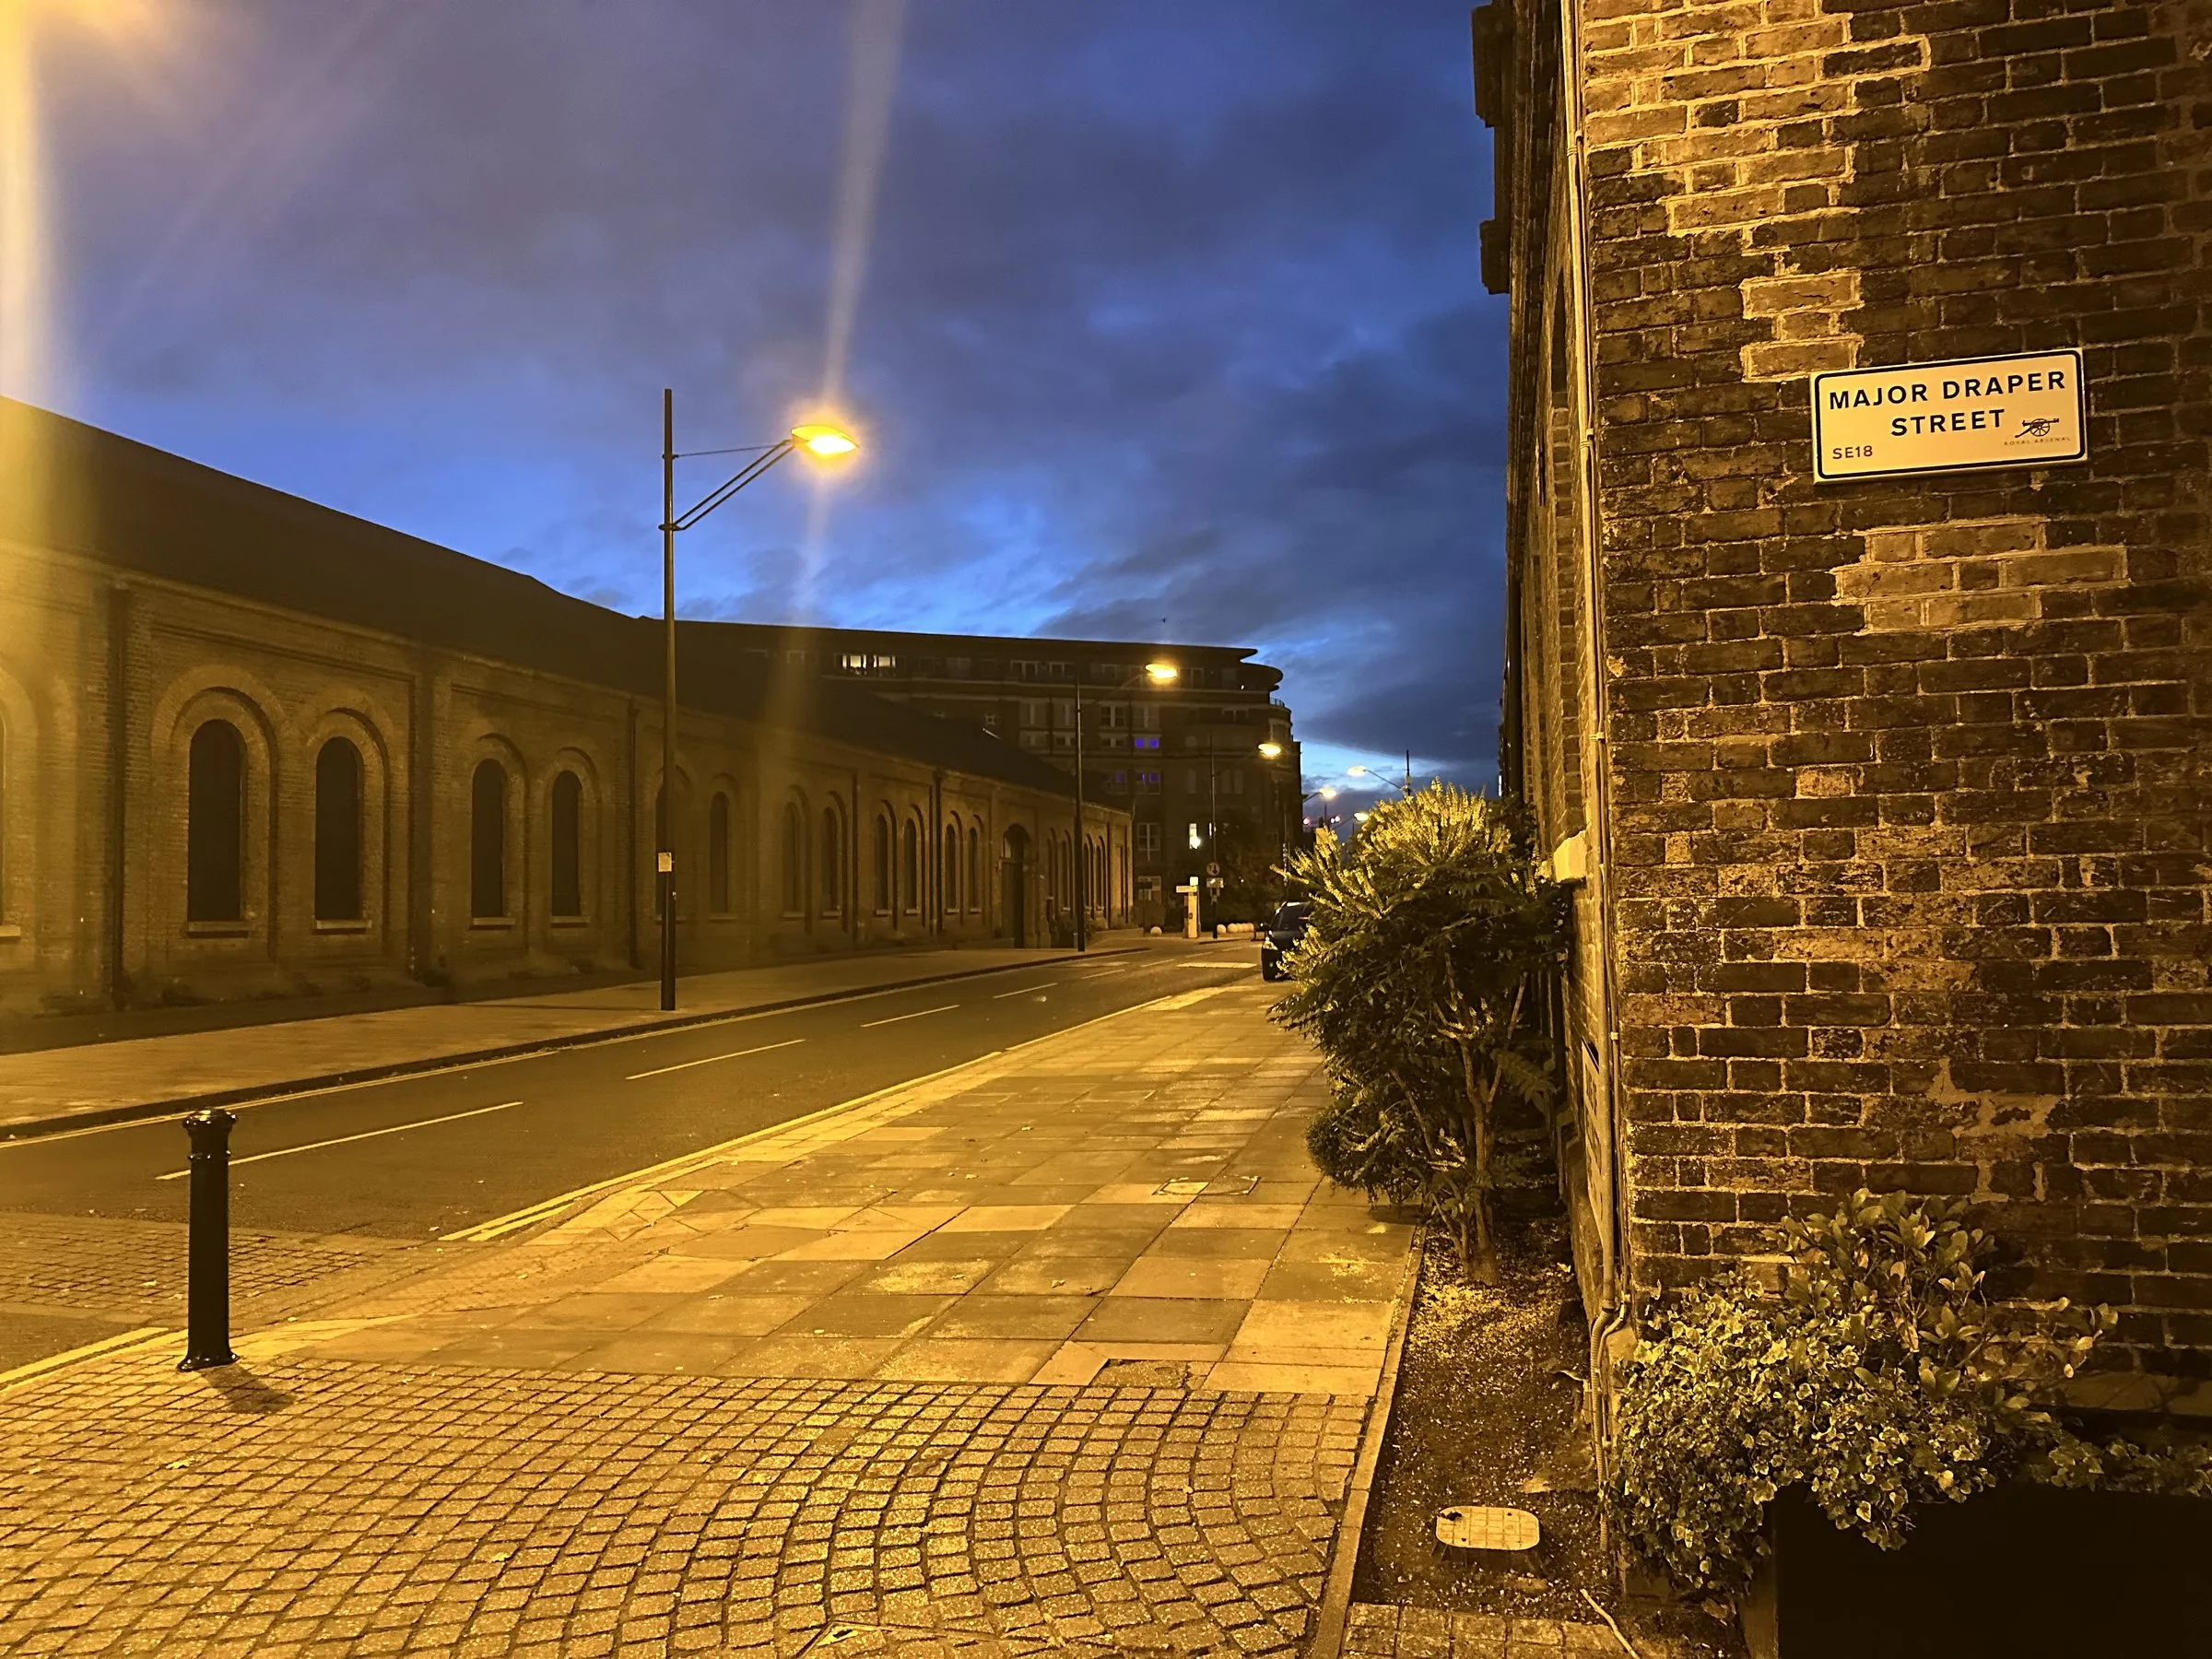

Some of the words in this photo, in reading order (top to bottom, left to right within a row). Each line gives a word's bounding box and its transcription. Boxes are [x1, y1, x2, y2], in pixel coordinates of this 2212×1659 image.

[1830, 383, 1928, 410] MAJOR
[1942, 371, 2065, 400] DRAPER
[1890, 408, 2005, 437] STREET
[1832, 445, 1873, 460] SE18
